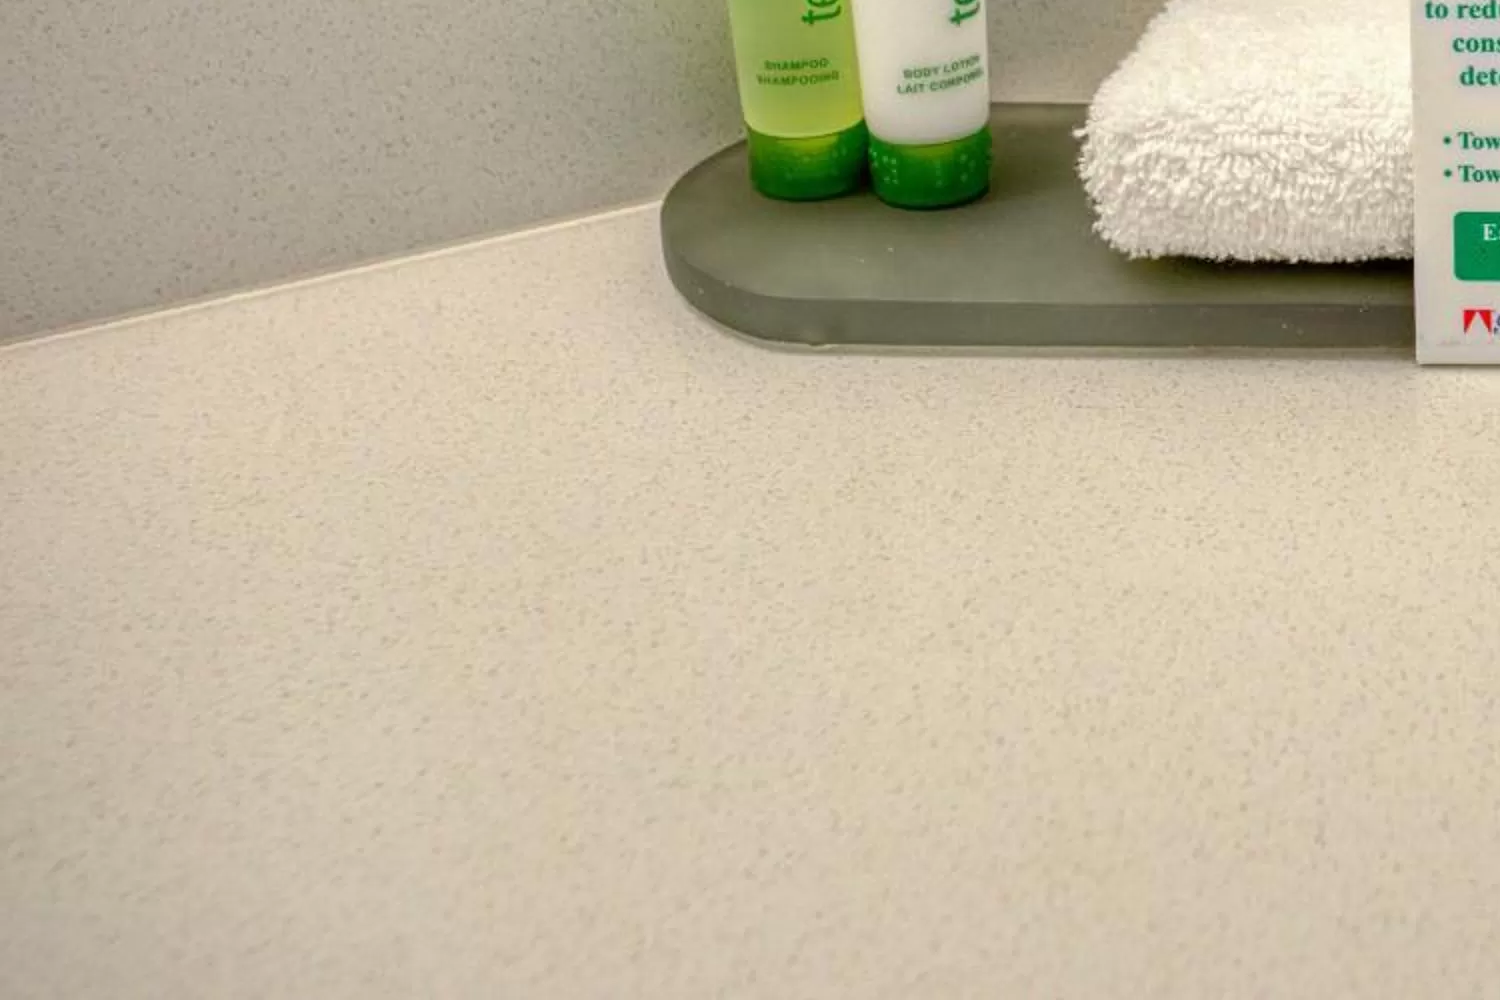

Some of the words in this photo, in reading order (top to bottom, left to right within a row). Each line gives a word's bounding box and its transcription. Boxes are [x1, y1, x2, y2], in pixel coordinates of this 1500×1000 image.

[1425, 0, 1449, 19] to
[764, 57, 830, 70] SHAMPOO
[903, 66, 940, 79] BODY
[896, 83, 925, 94] LAIT
